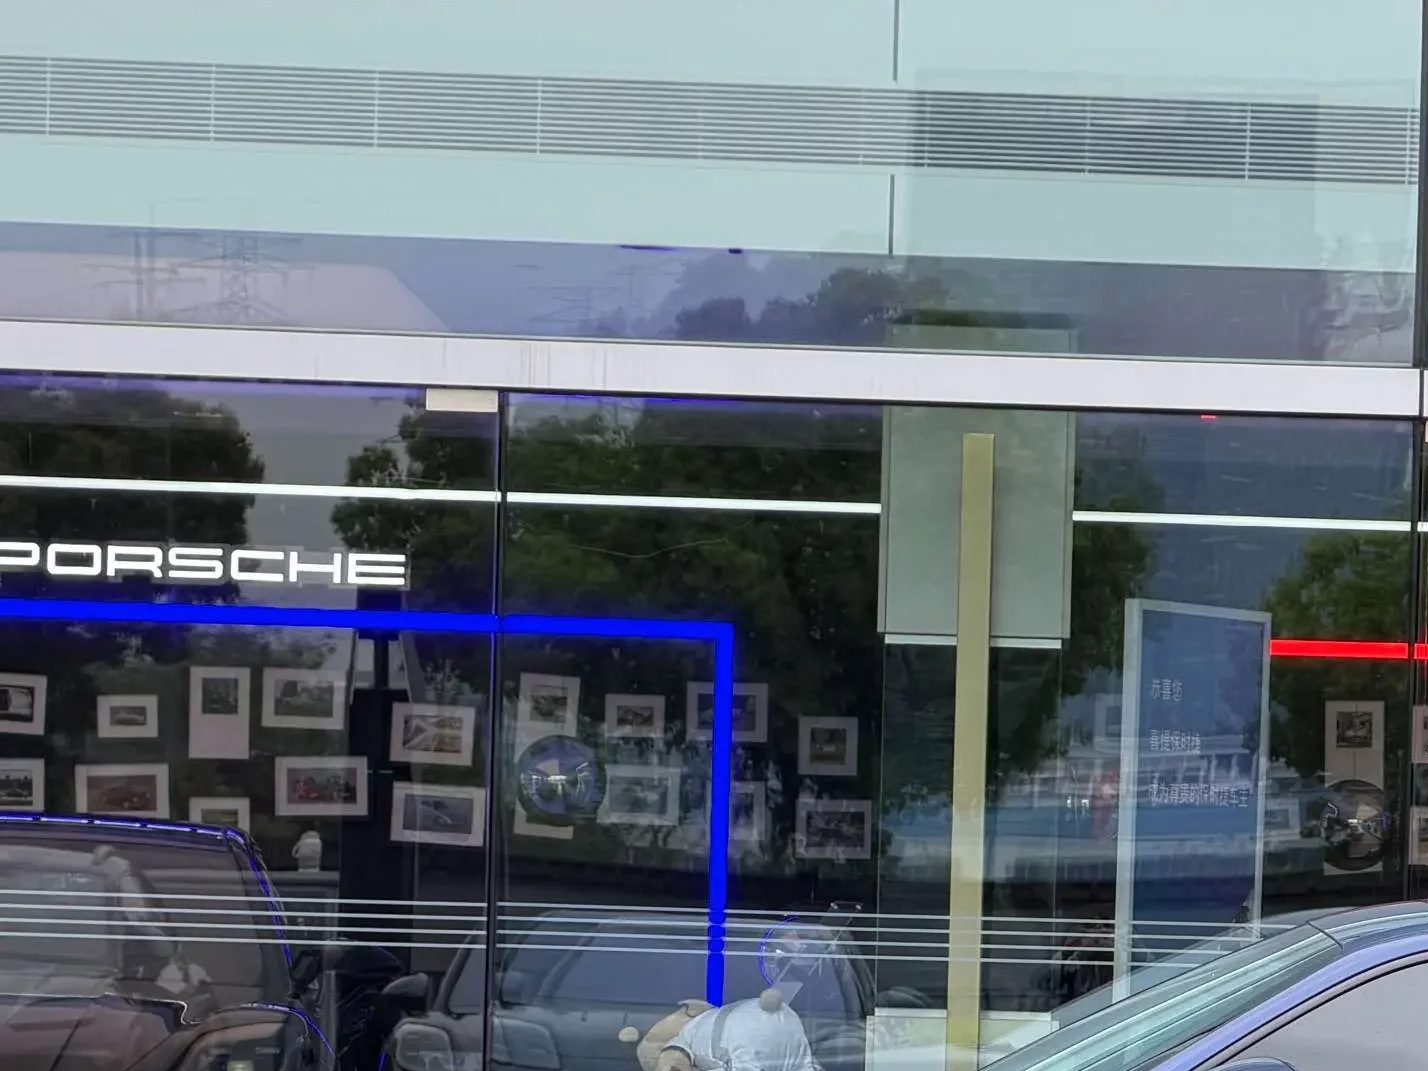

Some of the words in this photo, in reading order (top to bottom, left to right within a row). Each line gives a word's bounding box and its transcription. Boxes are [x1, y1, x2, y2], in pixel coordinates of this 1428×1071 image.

[0, 541, 406, 585] PORSCHE
[1151, 679, 1182, 702] 恭喜您
